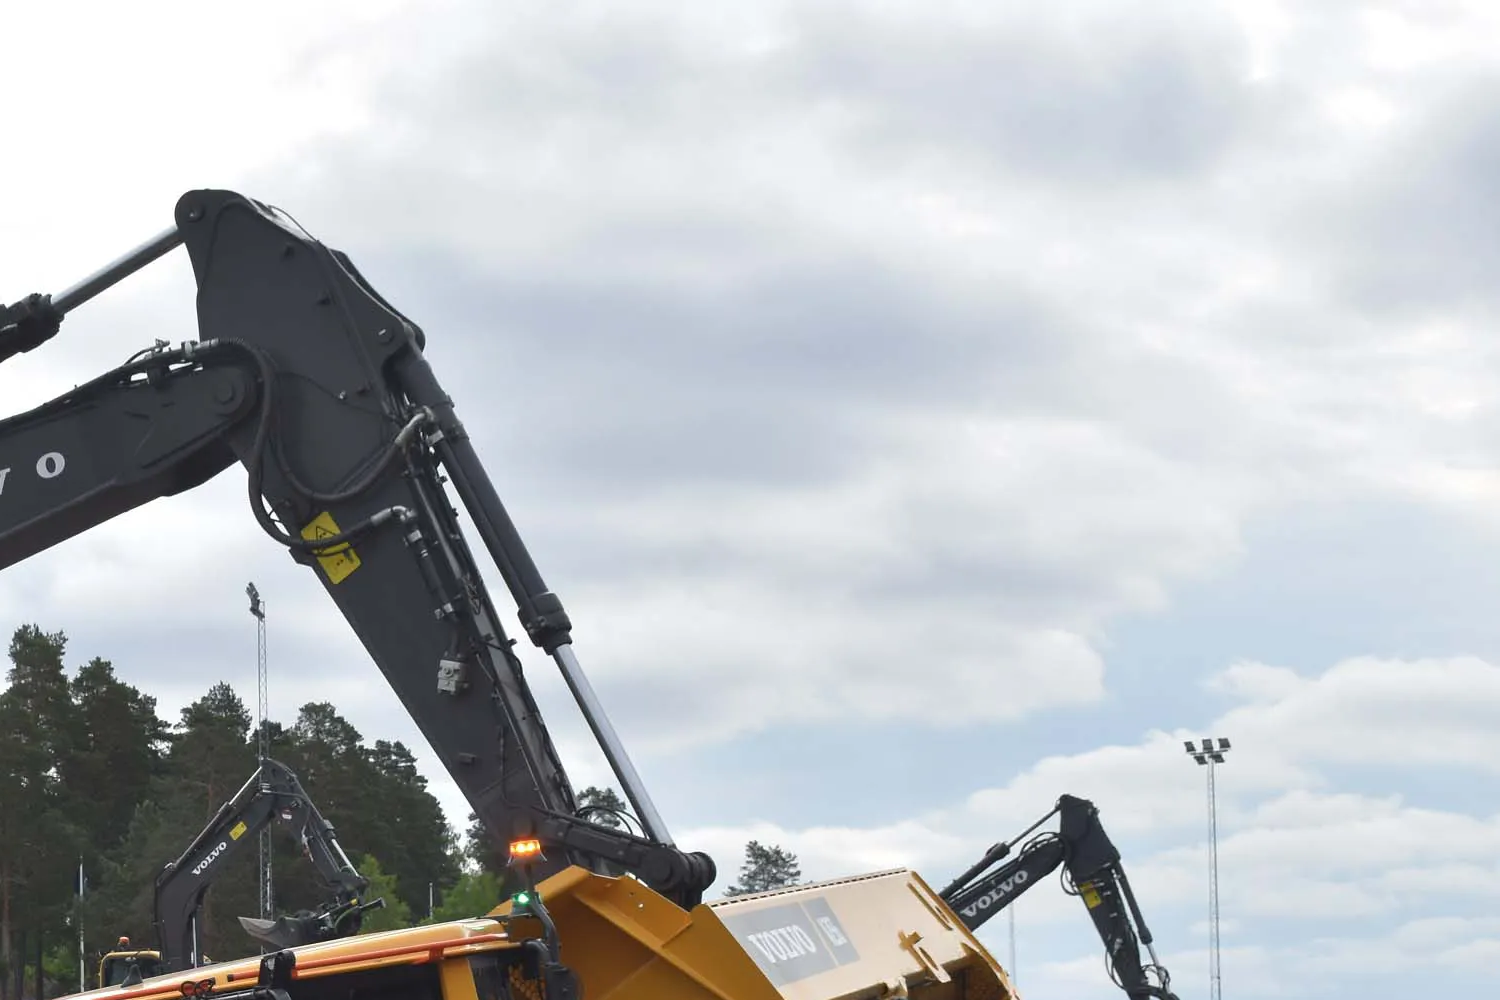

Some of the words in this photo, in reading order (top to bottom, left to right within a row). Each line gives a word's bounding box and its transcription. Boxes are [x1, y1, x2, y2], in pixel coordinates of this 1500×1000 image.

[192, 841, 227, 875] VOLVO
[960, 870, 1028, 917] VOLVO
[747, 924, 817, 964] VOLVO
